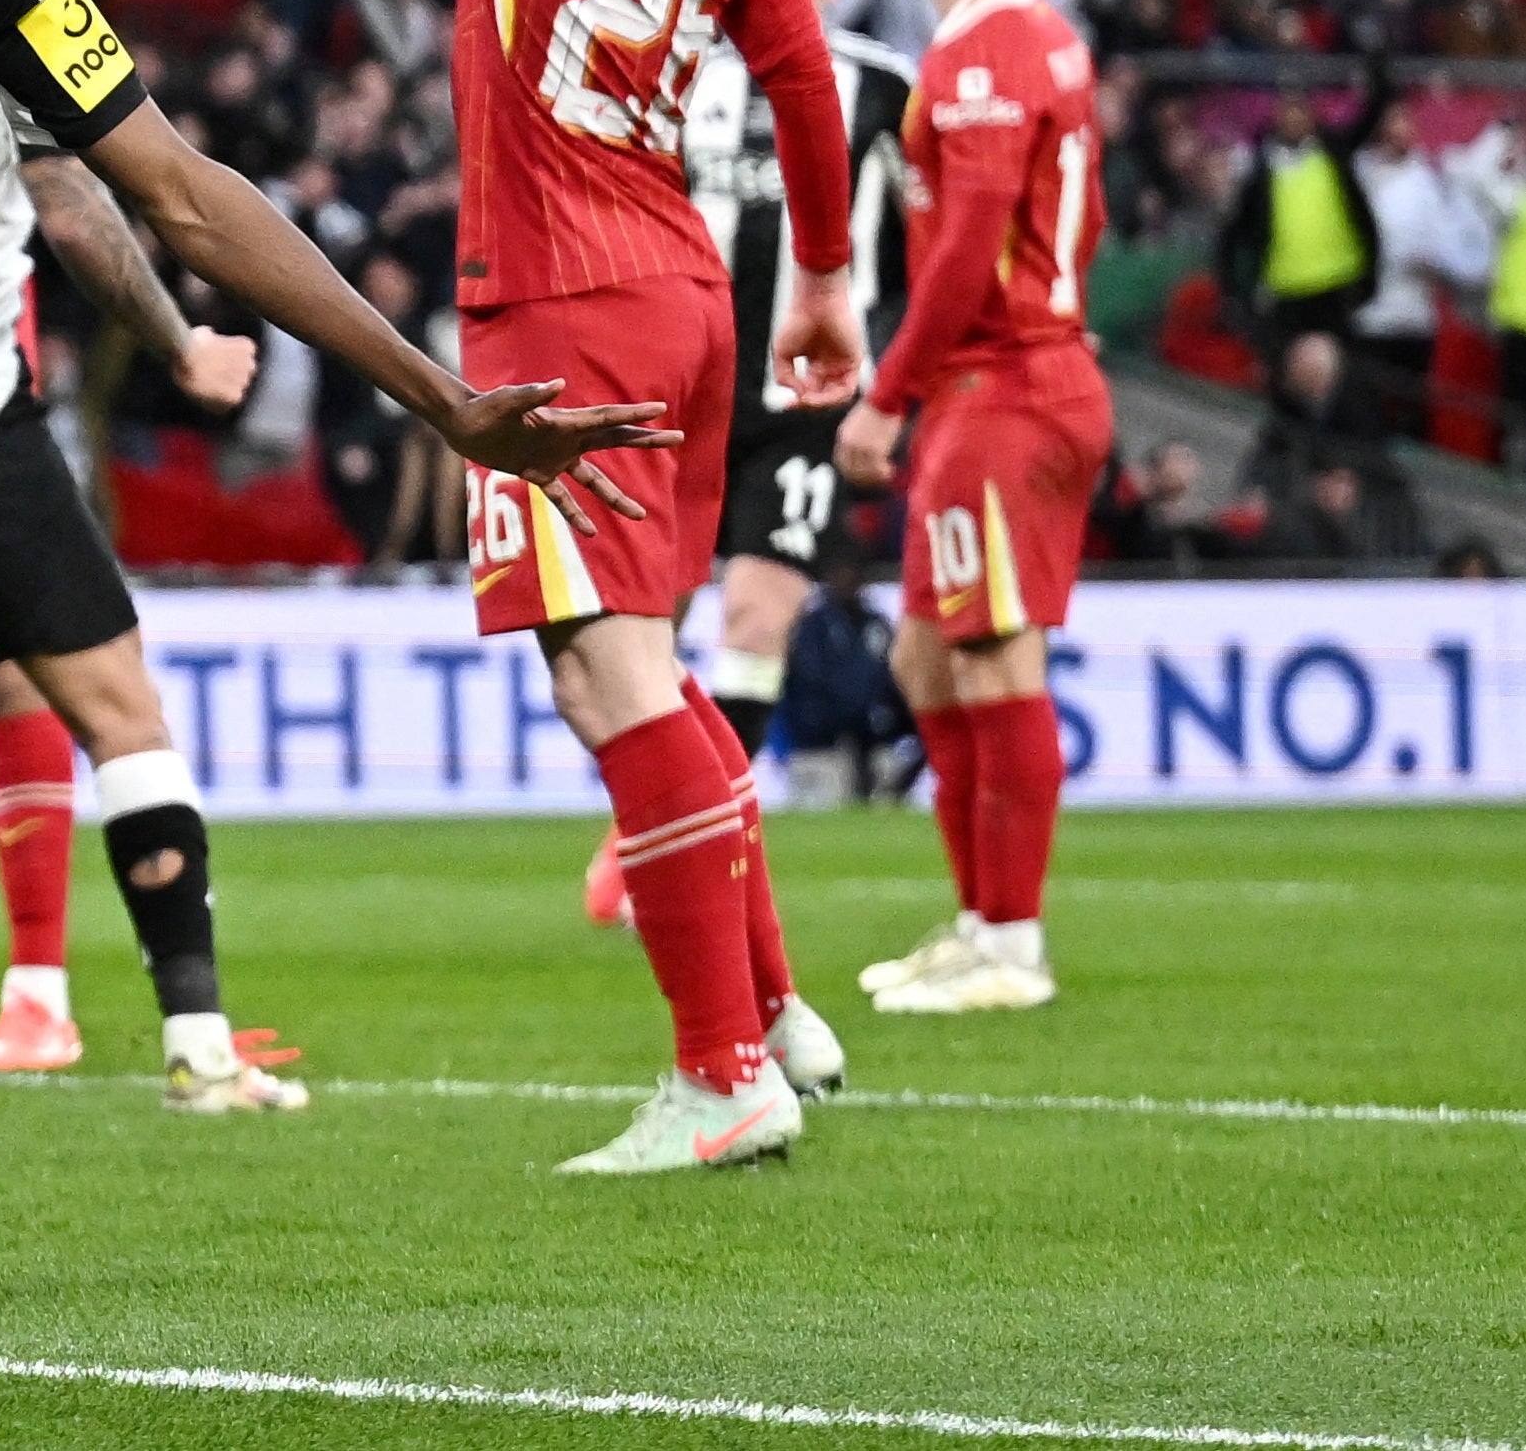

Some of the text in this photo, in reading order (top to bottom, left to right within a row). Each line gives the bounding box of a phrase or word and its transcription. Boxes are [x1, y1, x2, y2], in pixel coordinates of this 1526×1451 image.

[63, 33, 119, 89] noo
[925, 504, 984, 593] 10
[1148, 640, 1474, 778] NO.1
